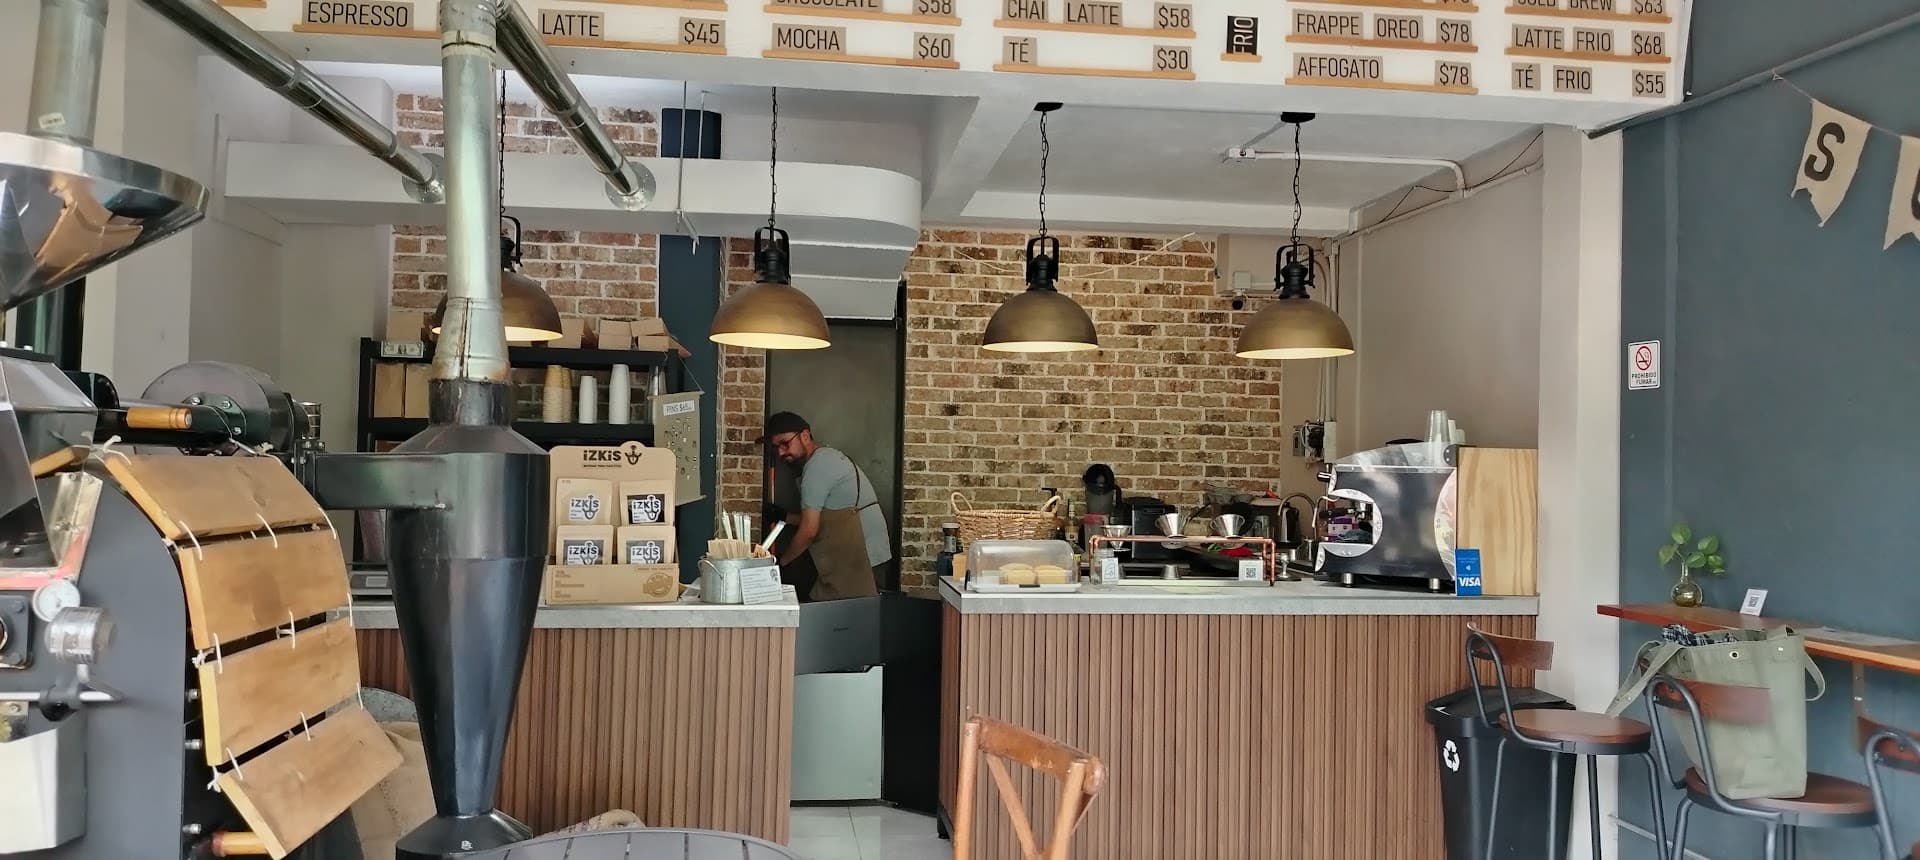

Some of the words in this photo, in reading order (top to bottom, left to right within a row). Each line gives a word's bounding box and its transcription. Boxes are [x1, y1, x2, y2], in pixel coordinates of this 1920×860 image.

[307, 1, 408, 27] ESPRESSO
[918, 0, 952, 15] $58
[1007, 0, 1045, 20] CHAI
[1067, 2, 1119, 25] LATTE
[1158, 6, 1190, 29] $58
[1634, 0, 1663, 15] $63
[542, 13, 600, 37] LATTE
[684, 20, 720, 45] $45
[1233, 17, 1254, 54] FRIO
[1296, 13, 1360, 36] FRAPPE
[1377, 17, 1419, 39] OREO
[1440, 21, 1470, 43] $78
[1515, 27, 1562, 50] LATTE
[1576, 31, 1611, 52] FRIO
[1634, 34, 1662, 56] $68
[777, 27, 840, 50] MOCHA
[918, 35, 951, 59] $60
[1009, 39, 1029, 63] TÉ
[1157, 47, 1189, 71] $30
[1297, 57, 1380, 79] AFFOGATO
[1439, 63, 1469, 86] $78
[1515, 65, 1533, 88] TÉ
[1556, 69, 1591, 90] FRIO
[1635, 72, 1664, 95] $55
[1804, 122, 1845, 181] S
[1458, 577, 1481, 587] VISA
